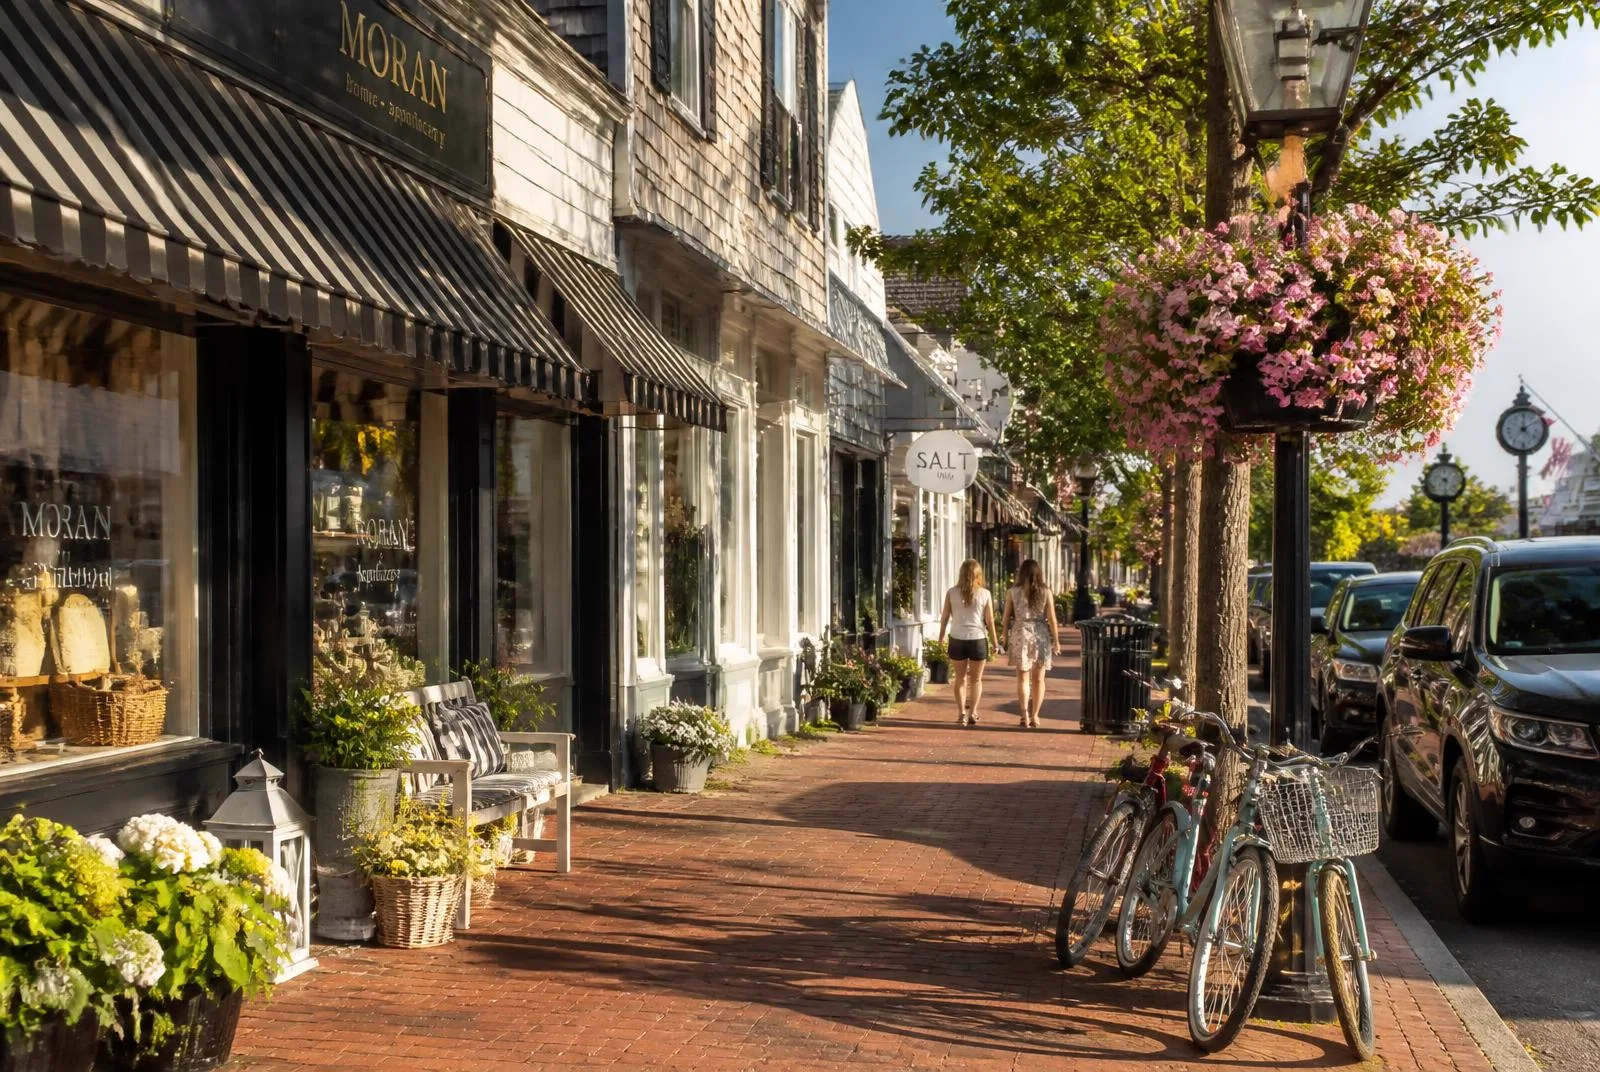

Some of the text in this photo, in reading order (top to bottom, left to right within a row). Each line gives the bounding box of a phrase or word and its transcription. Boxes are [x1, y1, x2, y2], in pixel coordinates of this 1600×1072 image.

[339, 0, 447, 114] MORAN
[916, 451, 972, 470] SALT
[20, 501, 111, 540] MORAN
